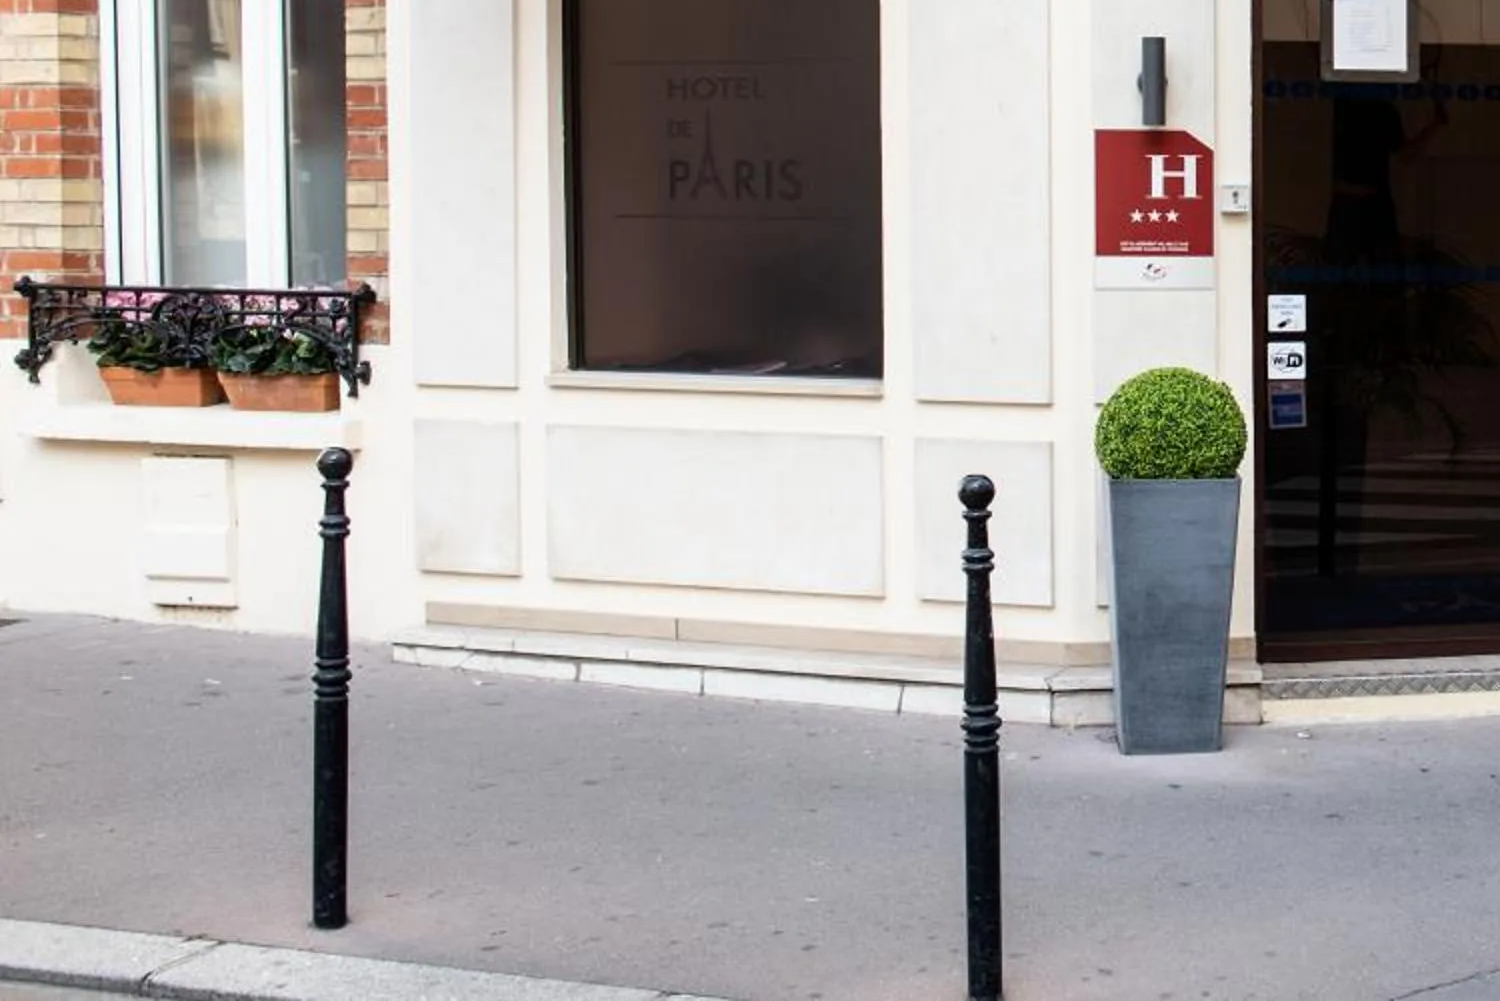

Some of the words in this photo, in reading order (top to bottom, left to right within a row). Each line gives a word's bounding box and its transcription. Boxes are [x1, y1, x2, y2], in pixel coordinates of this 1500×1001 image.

[667, 77, 767, 100] HOTEL
[667, 119, 693, 138] DE
[1144, 154, 1204, 199] H
